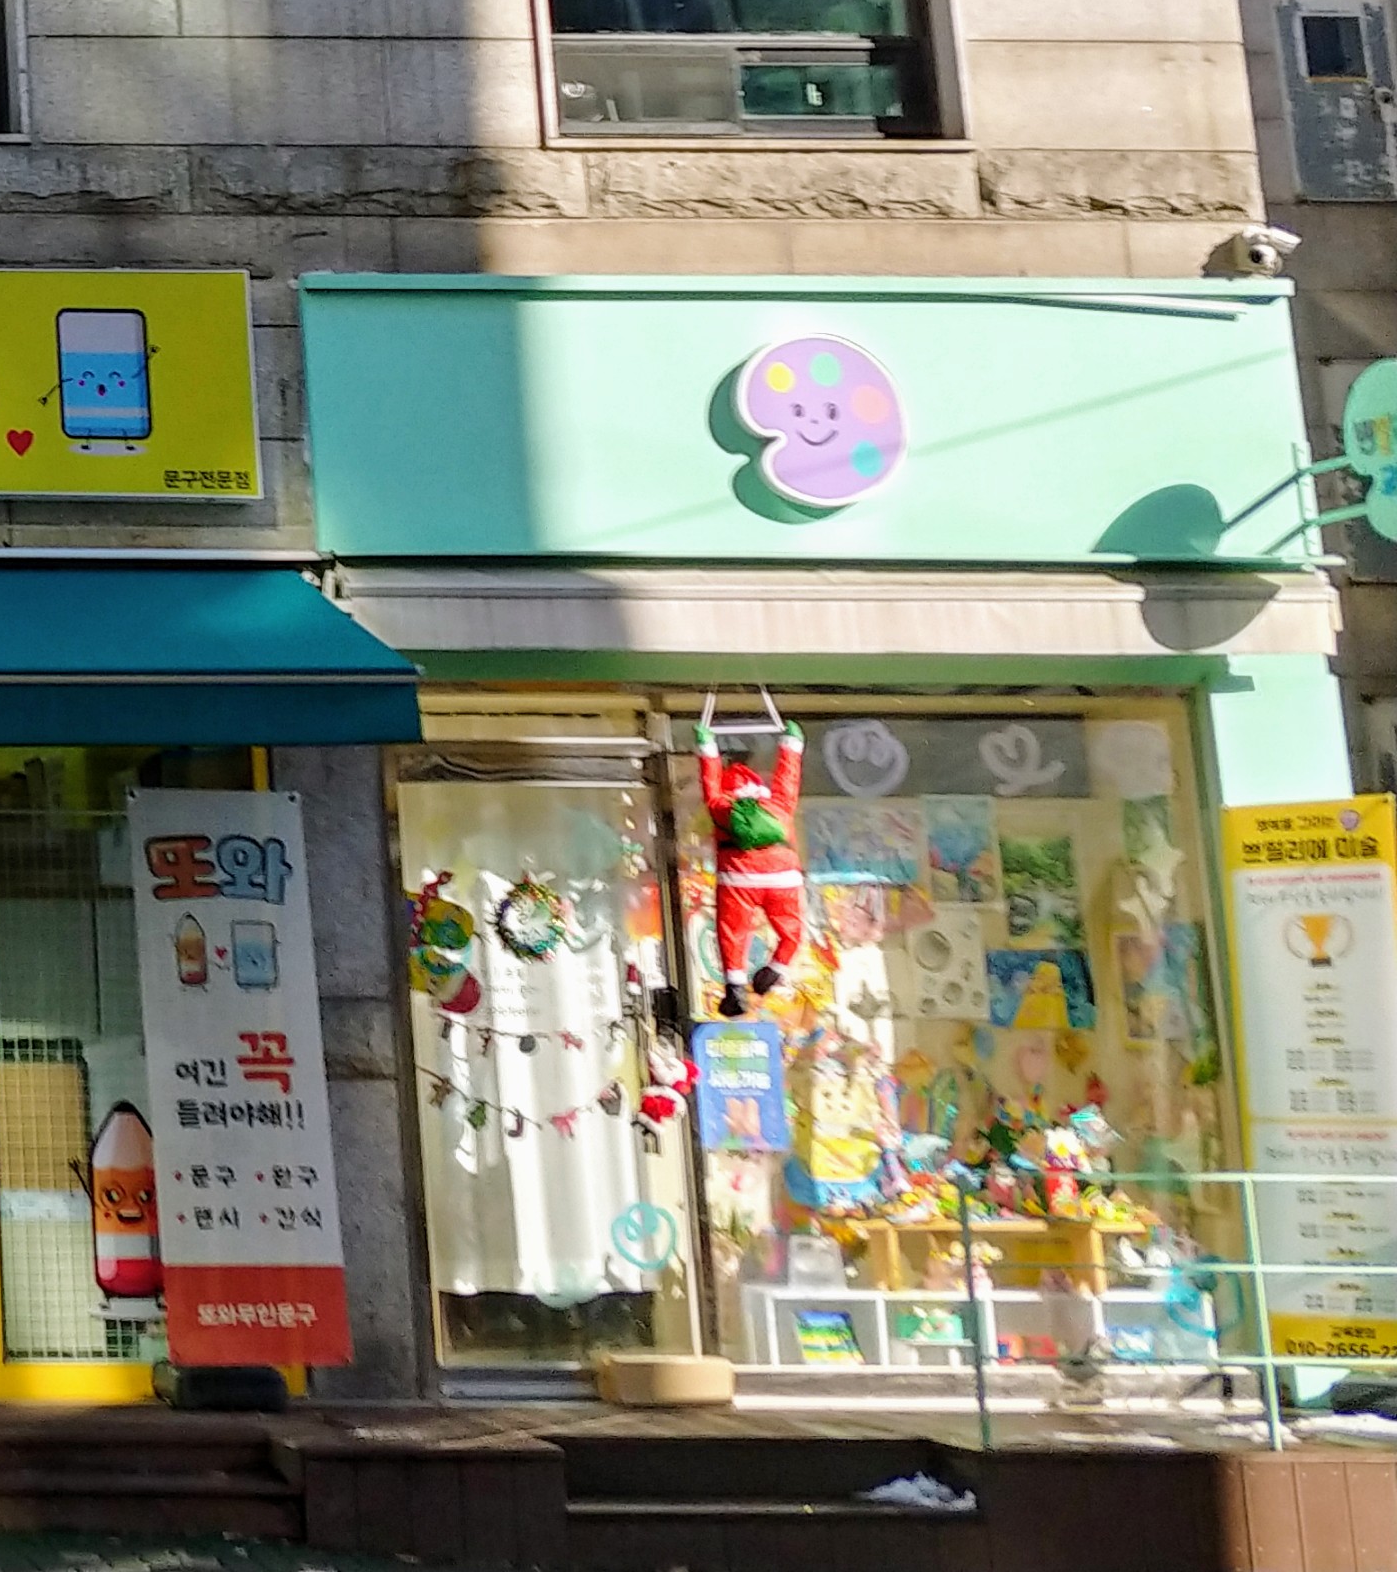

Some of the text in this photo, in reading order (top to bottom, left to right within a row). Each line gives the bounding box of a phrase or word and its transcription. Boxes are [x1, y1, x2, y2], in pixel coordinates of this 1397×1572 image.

[144, 833, 294, 906] 또와
[175, 1030, 295, 1096] 여긴 꼭
